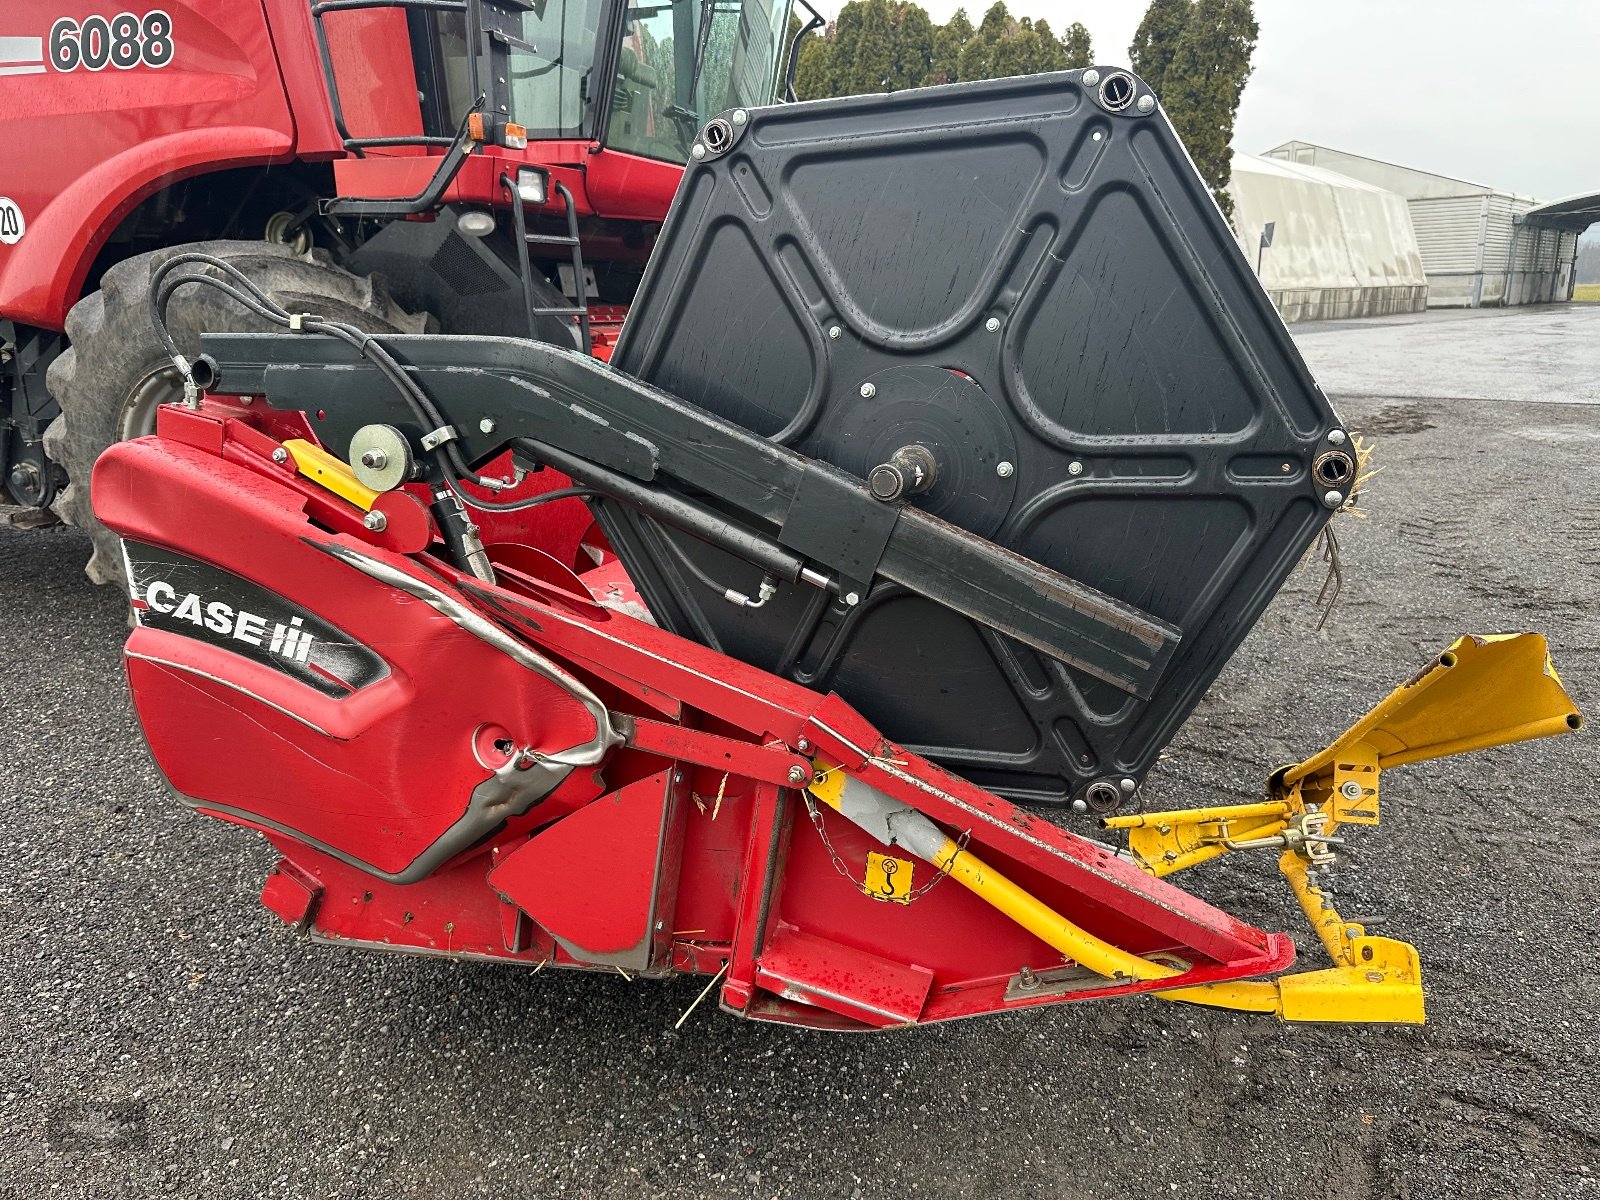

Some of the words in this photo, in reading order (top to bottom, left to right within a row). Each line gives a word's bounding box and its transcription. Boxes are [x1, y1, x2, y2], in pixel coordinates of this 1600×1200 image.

[49, 10, 174, 73] 6088
[0, 206, 19, 236] 20
[146, 581, 268, 646] CASE
